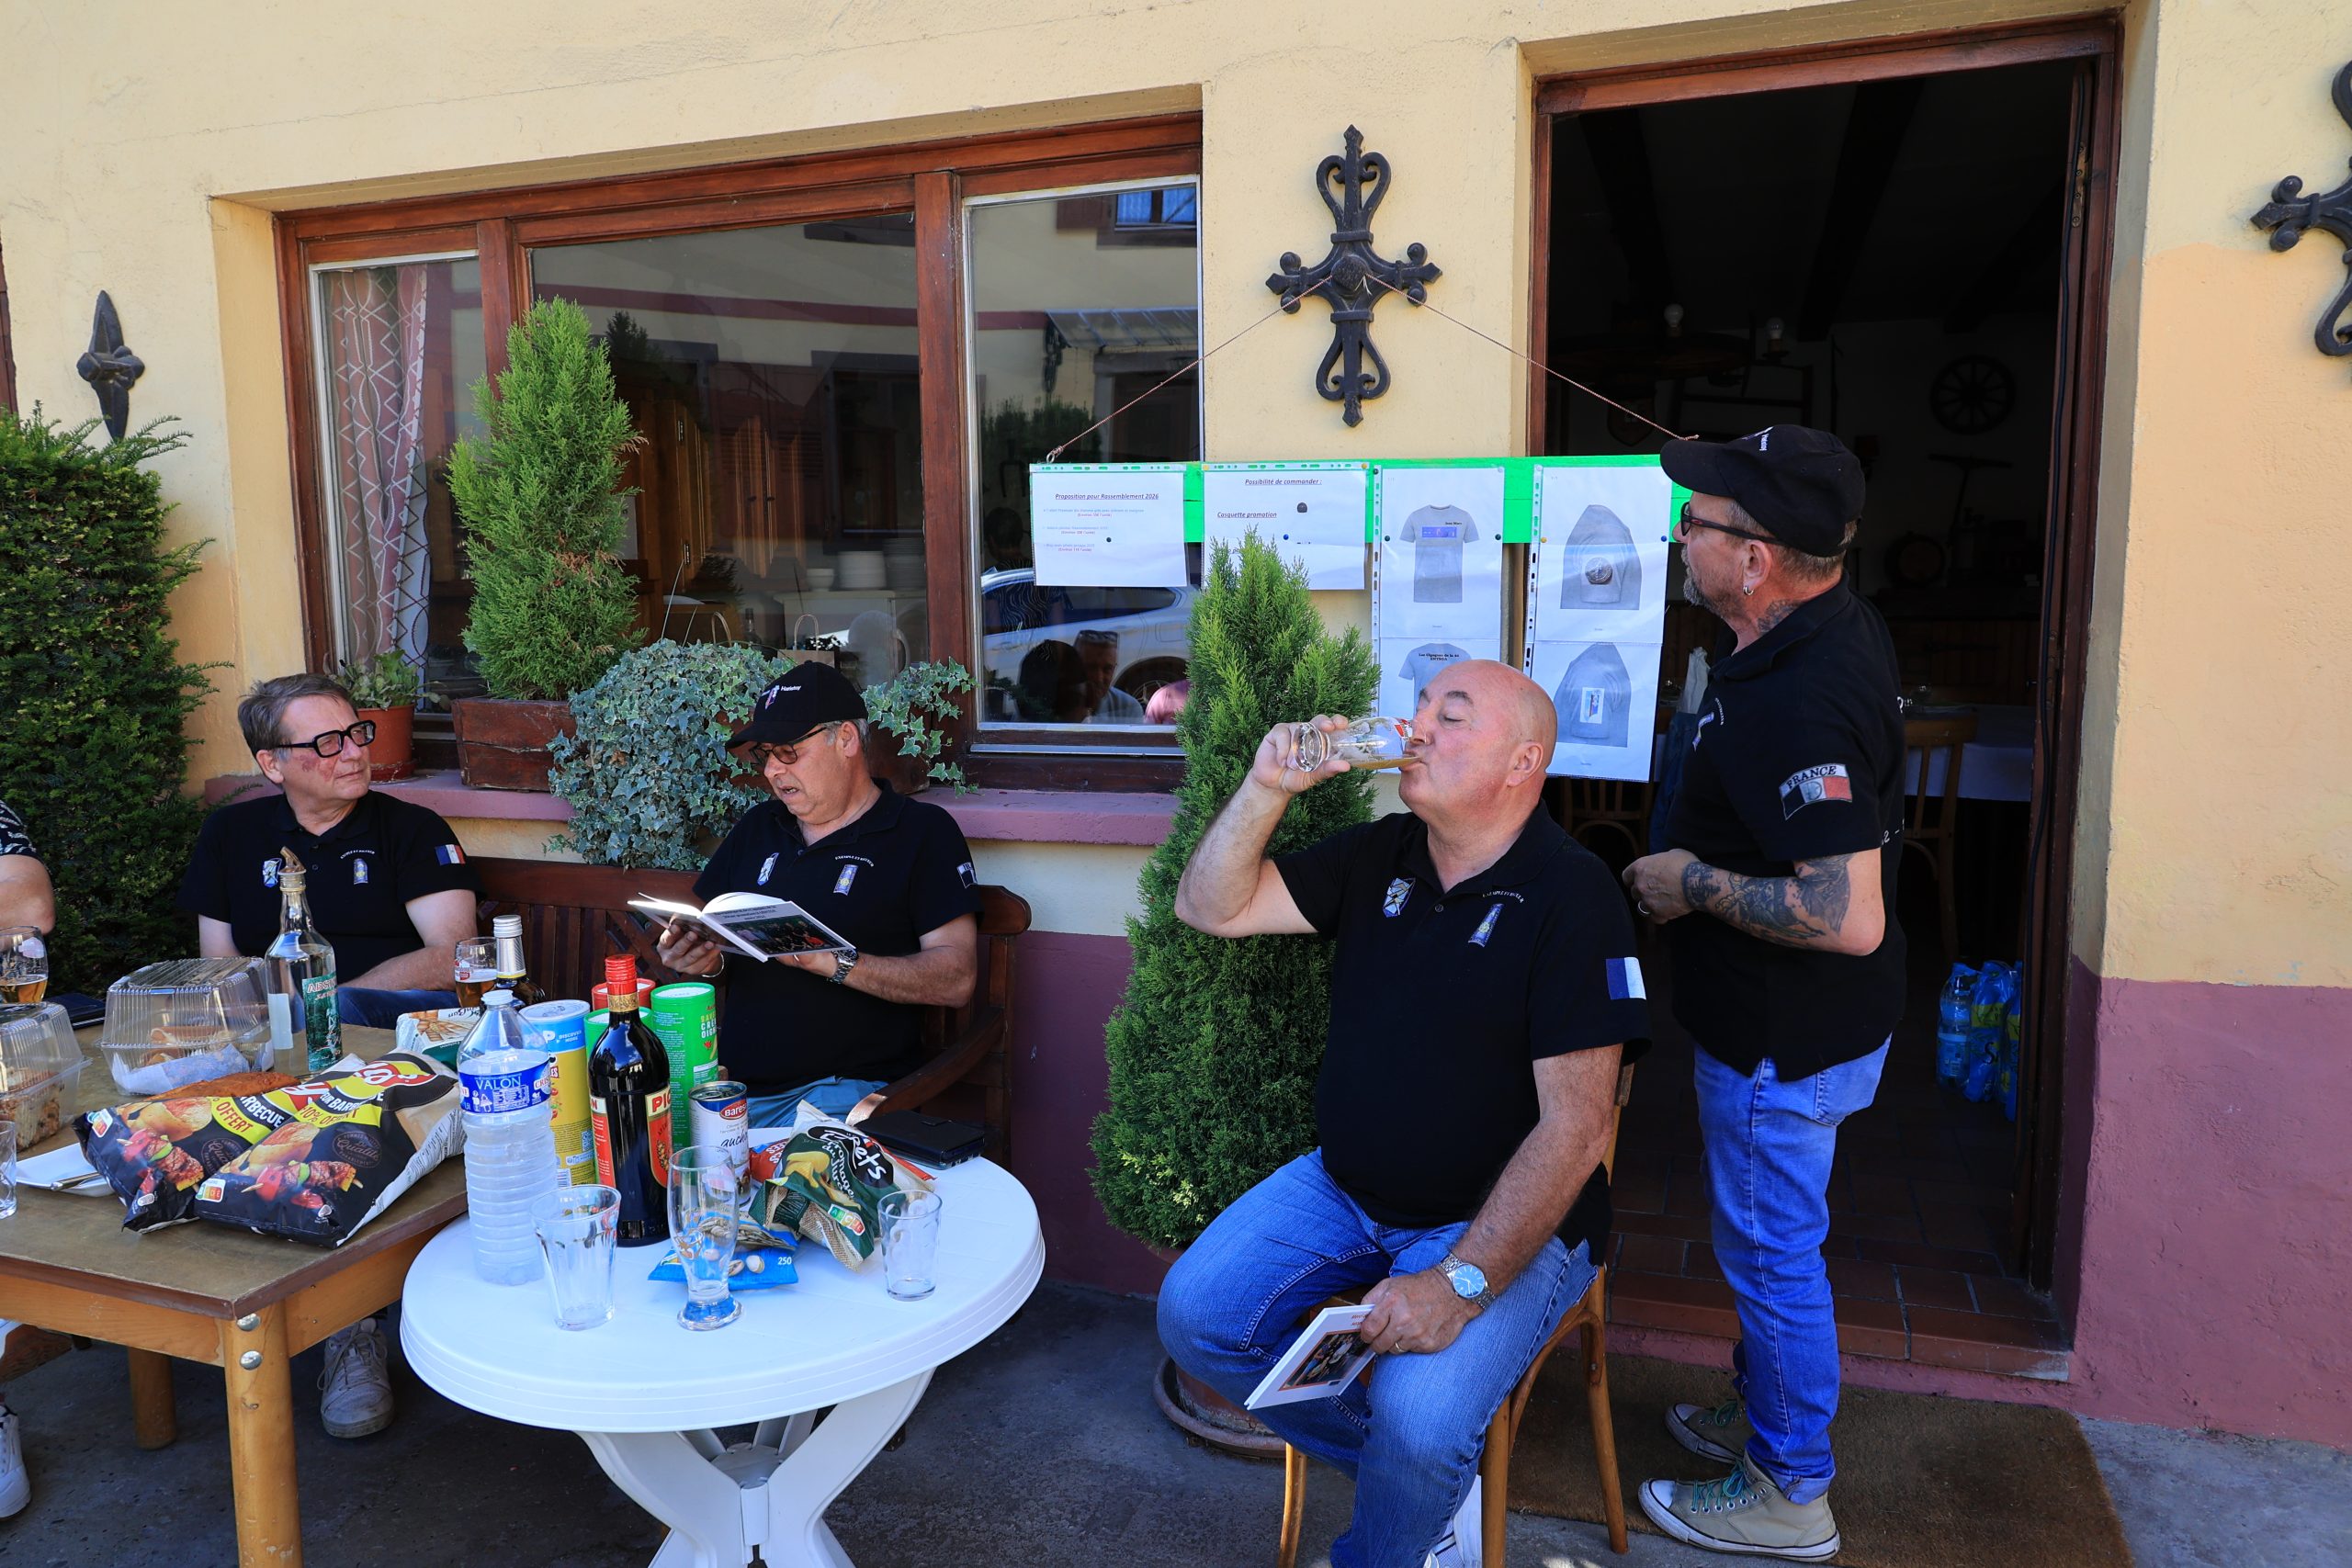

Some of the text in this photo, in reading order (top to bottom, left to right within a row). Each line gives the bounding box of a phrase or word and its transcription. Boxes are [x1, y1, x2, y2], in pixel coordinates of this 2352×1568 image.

[1786, 765, 1837, 789] FRANCE
[475, 1076, 522, 1090] VALON
[216, 1101, 254, 1133] OFFERT
[777, 1257, 792, 1266] 250
